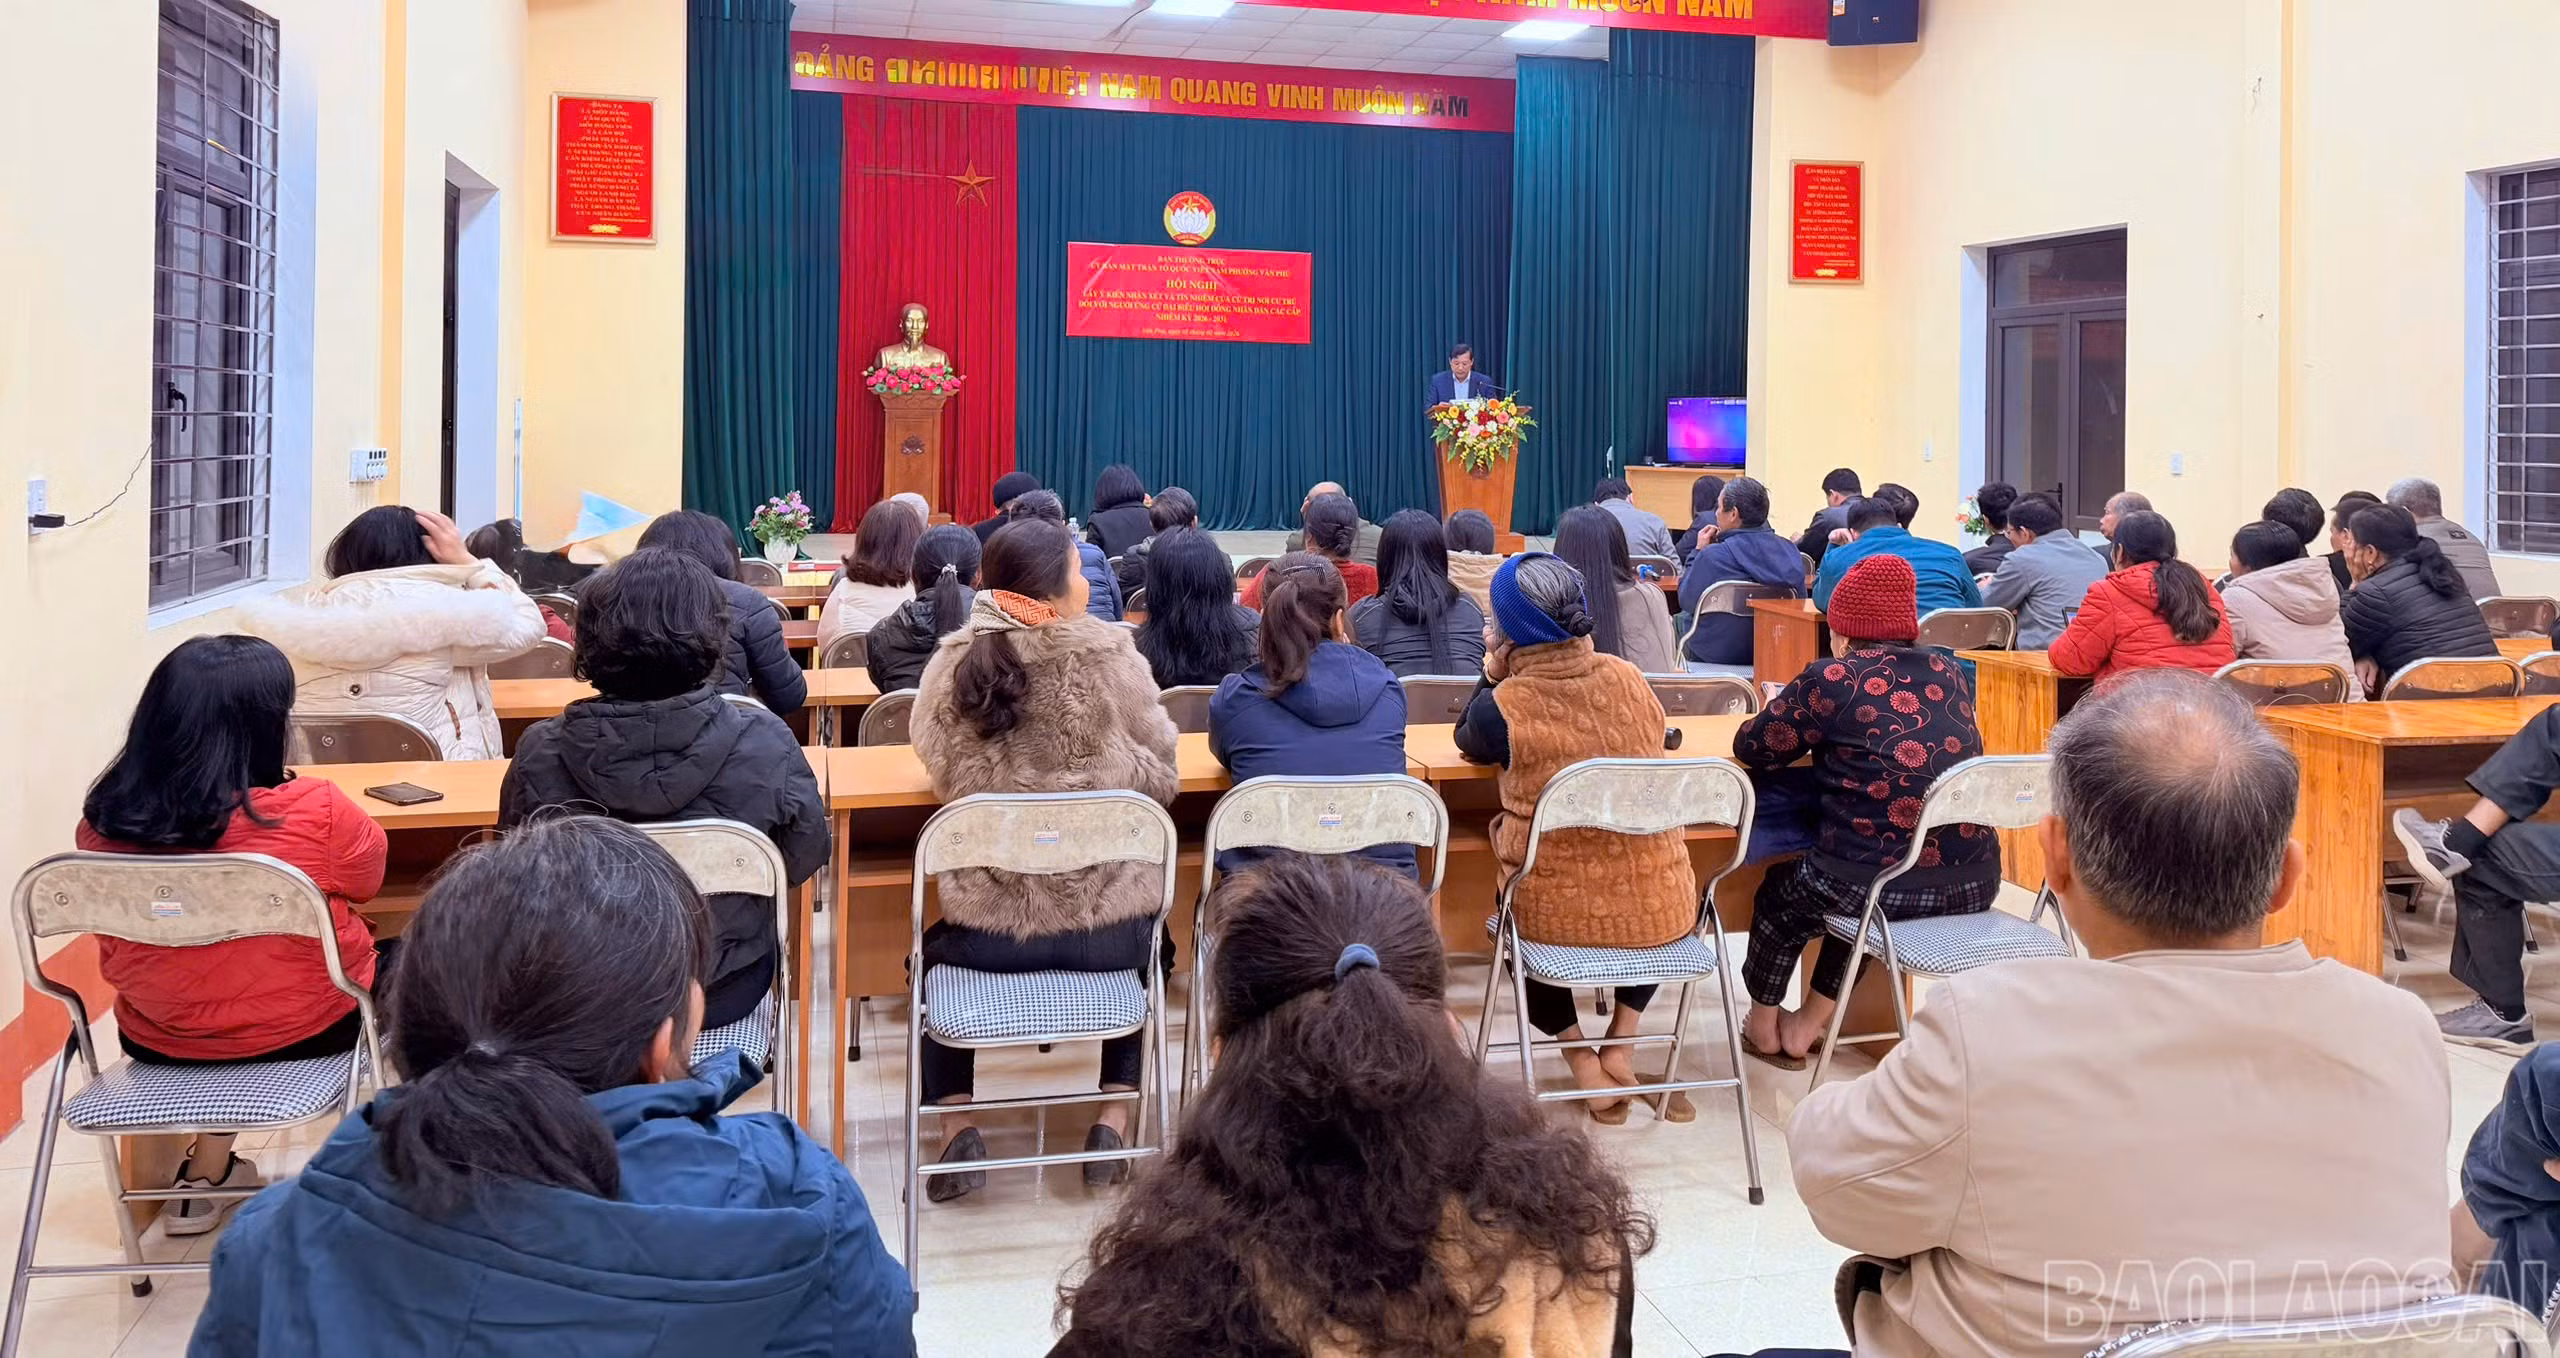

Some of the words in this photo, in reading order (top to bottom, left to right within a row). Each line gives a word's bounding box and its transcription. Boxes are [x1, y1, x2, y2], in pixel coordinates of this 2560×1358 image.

[794, 44, 874, 82] ĐẢNG
[1038, 65, 1090, 100] VIỆT
[1100, 72, 1161, 100] NAM
[1170, 77, 1257, 106] QUANG
[1266, 83, 1324, 110] VINH
[1332, 84, 1406, 115] MUÔN
[1412, 88, 1470, 118] NĂM
[1166, 278, 1187, 289] HỘI
[1190, 280, 1216, 292] NGHỊ
